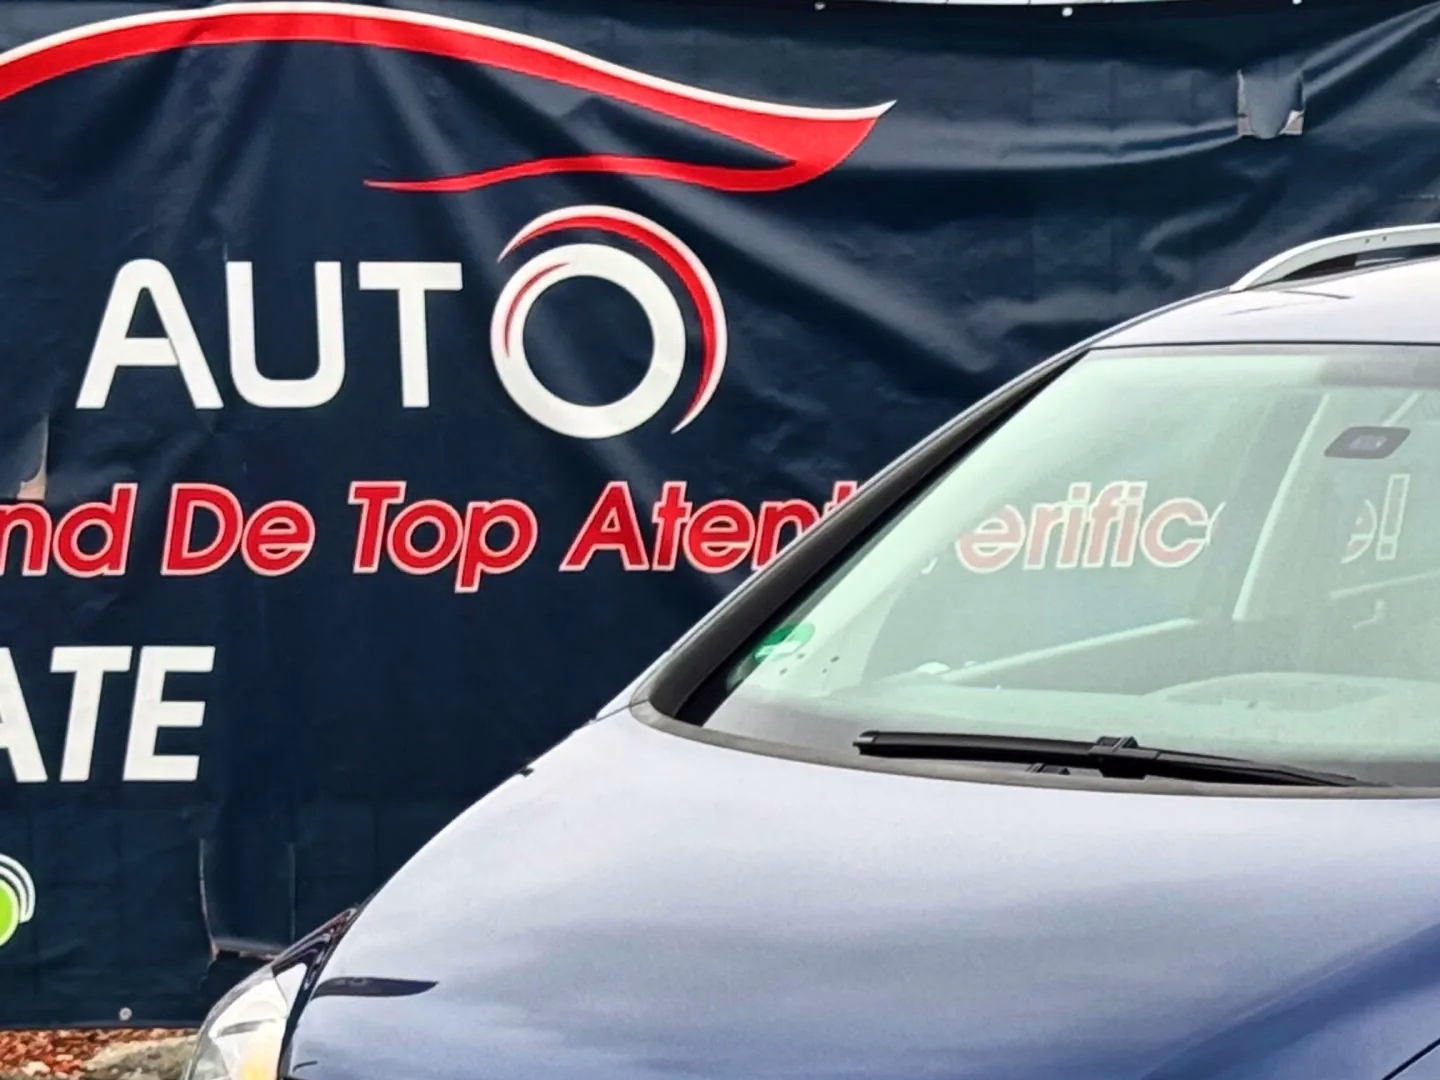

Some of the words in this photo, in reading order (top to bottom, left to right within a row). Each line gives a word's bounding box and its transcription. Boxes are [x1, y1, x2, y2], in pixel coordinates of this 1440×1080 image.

[76, 243, 690, 439] AUTO
[161, 482, 316, 577] De
[349, 481, 538, 594] Top
